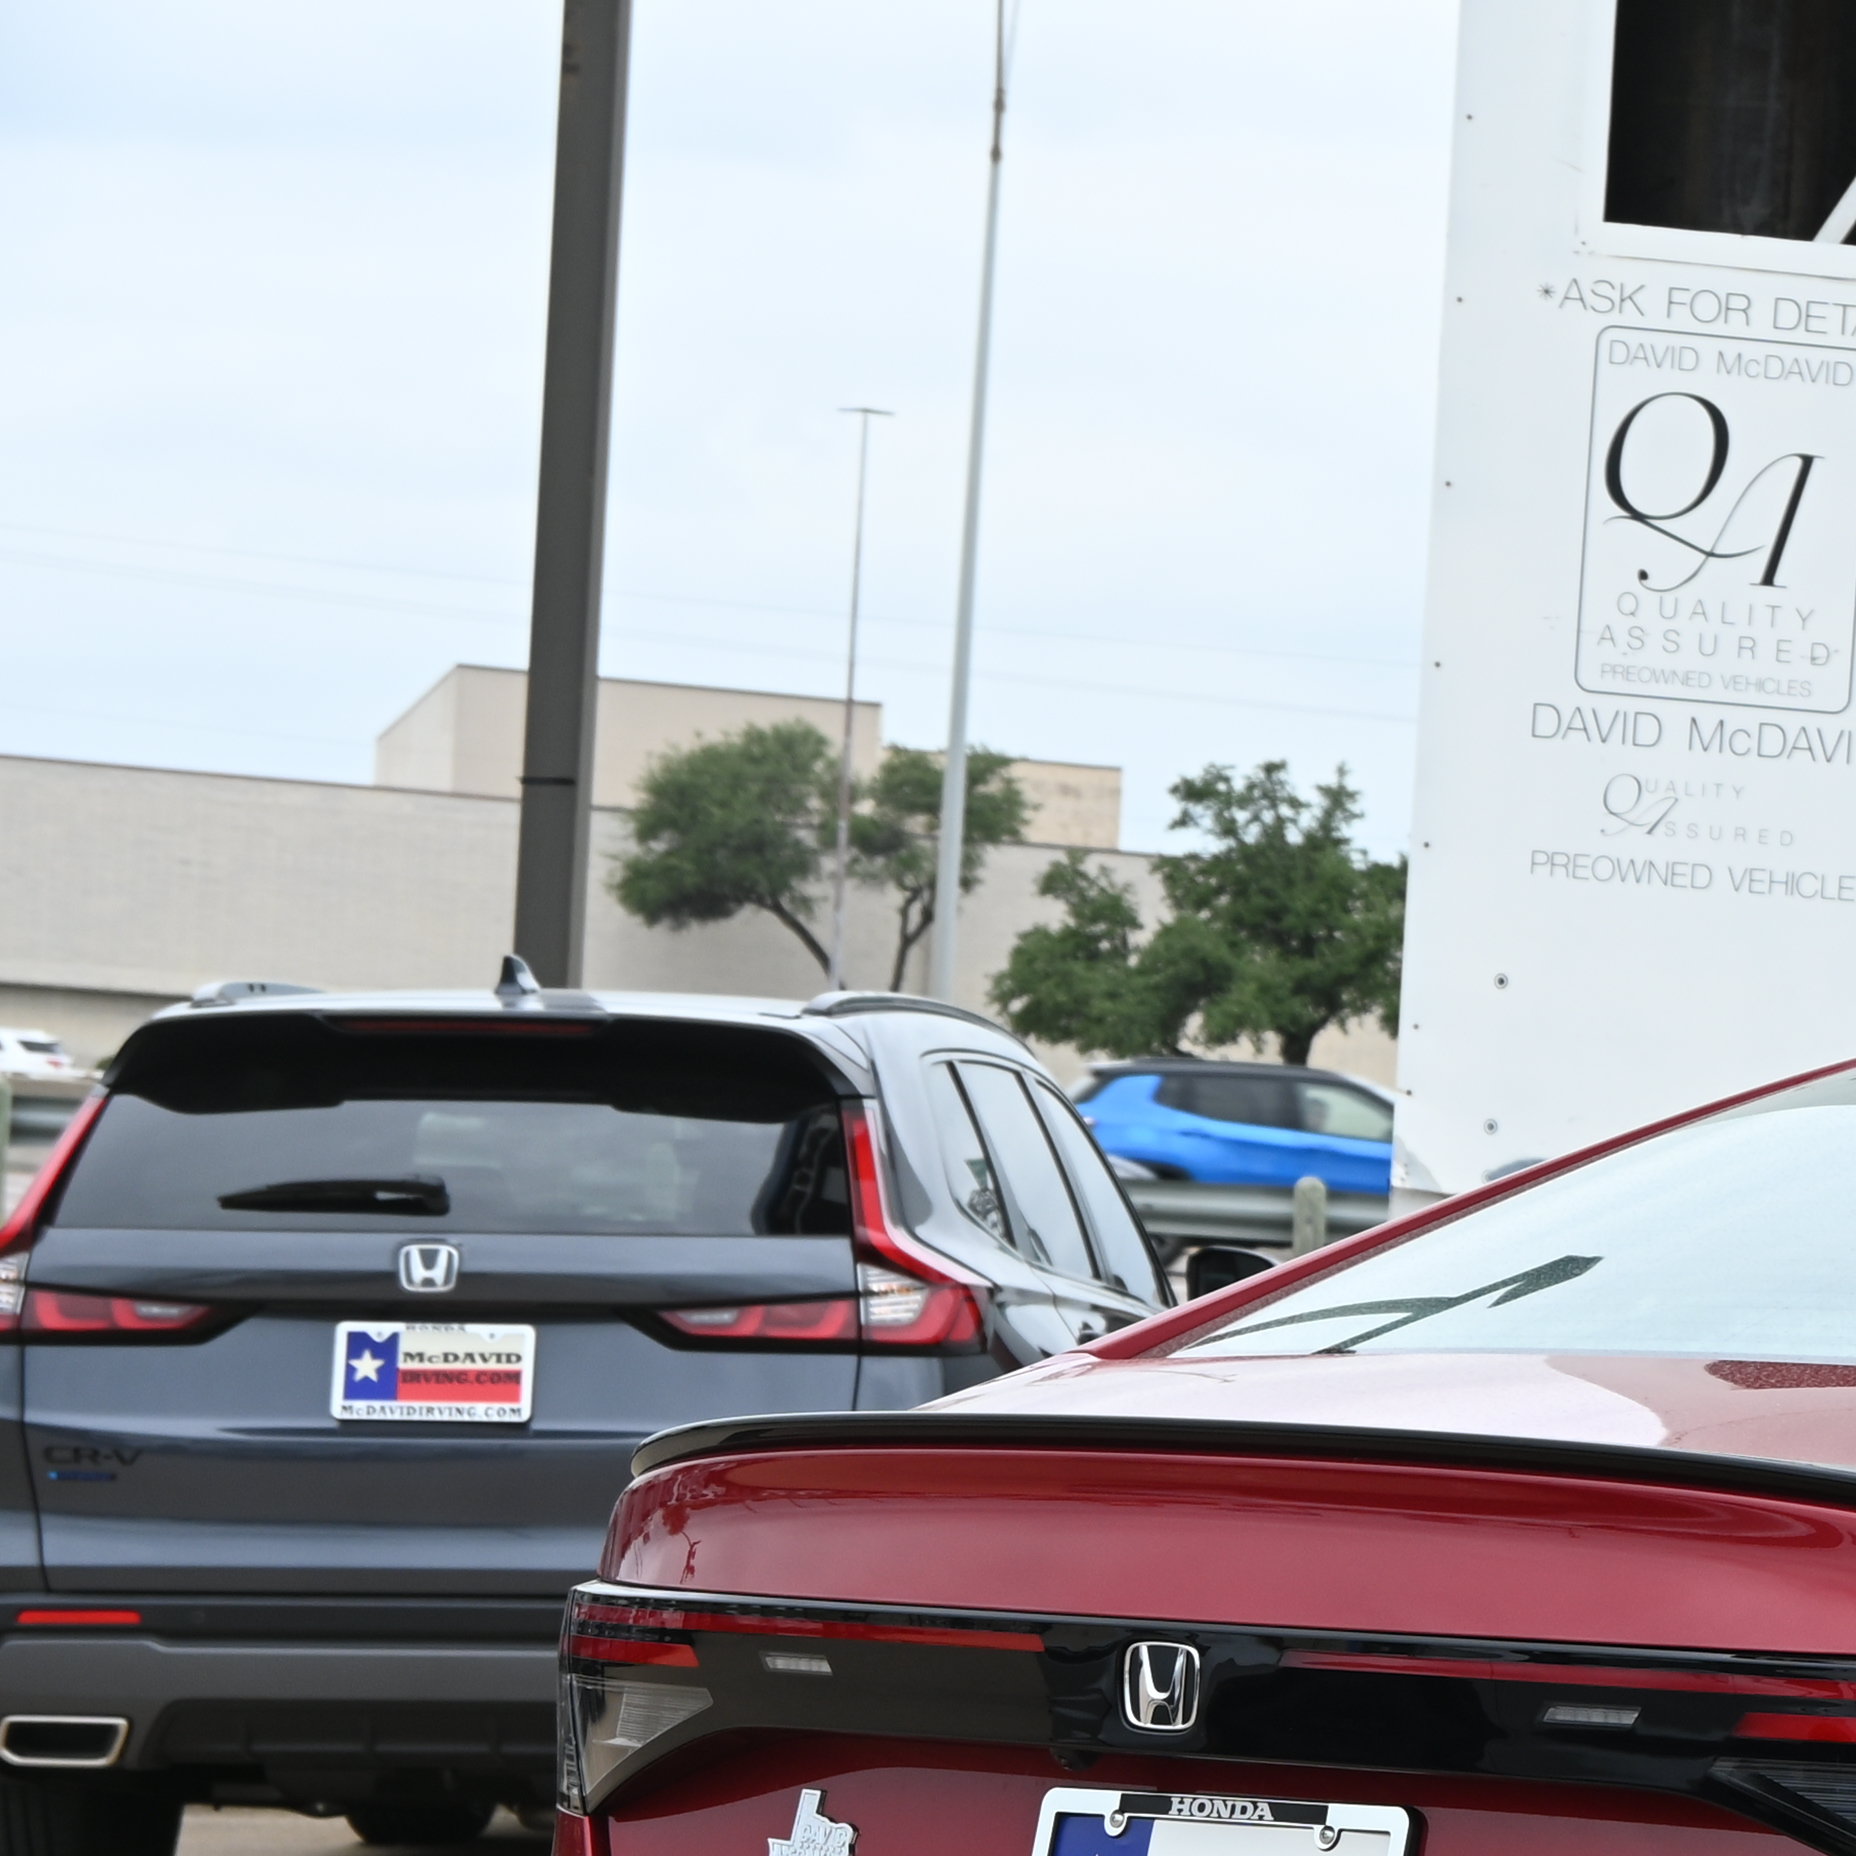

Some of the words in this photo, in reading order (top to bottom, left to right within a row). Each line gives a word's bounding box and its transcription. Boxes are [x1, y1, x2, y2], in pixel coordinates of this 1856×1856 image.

[1666, 287, 1752, 326] FOR
[1607, 338, 1700, 372] DAVID
[1716, 350, 1855, 388] McDAVID
[1616, 591, 1815, 631] QUALITY
[1597, 624, 1832, 667] ASSURED
[1600, 663, 1712, 690] PREOWNED
[1720, 672, 1813, 698] VEHICLES
[1530, 701, 1663, 748] DAVID
[1530, 850, 1712, 891] PREOWNED
[1728, 865, 1856, 902] VEHICLE
[403, 1352, 522, 1365] McDAVID
[401, 1370, 521, 1385] IRVING.COM
[43, 1446, 145, 1466] CR-V
[1168, 1797, 1274, 1822] HONDA
[801, 1824, 849, 1847] DAVID
